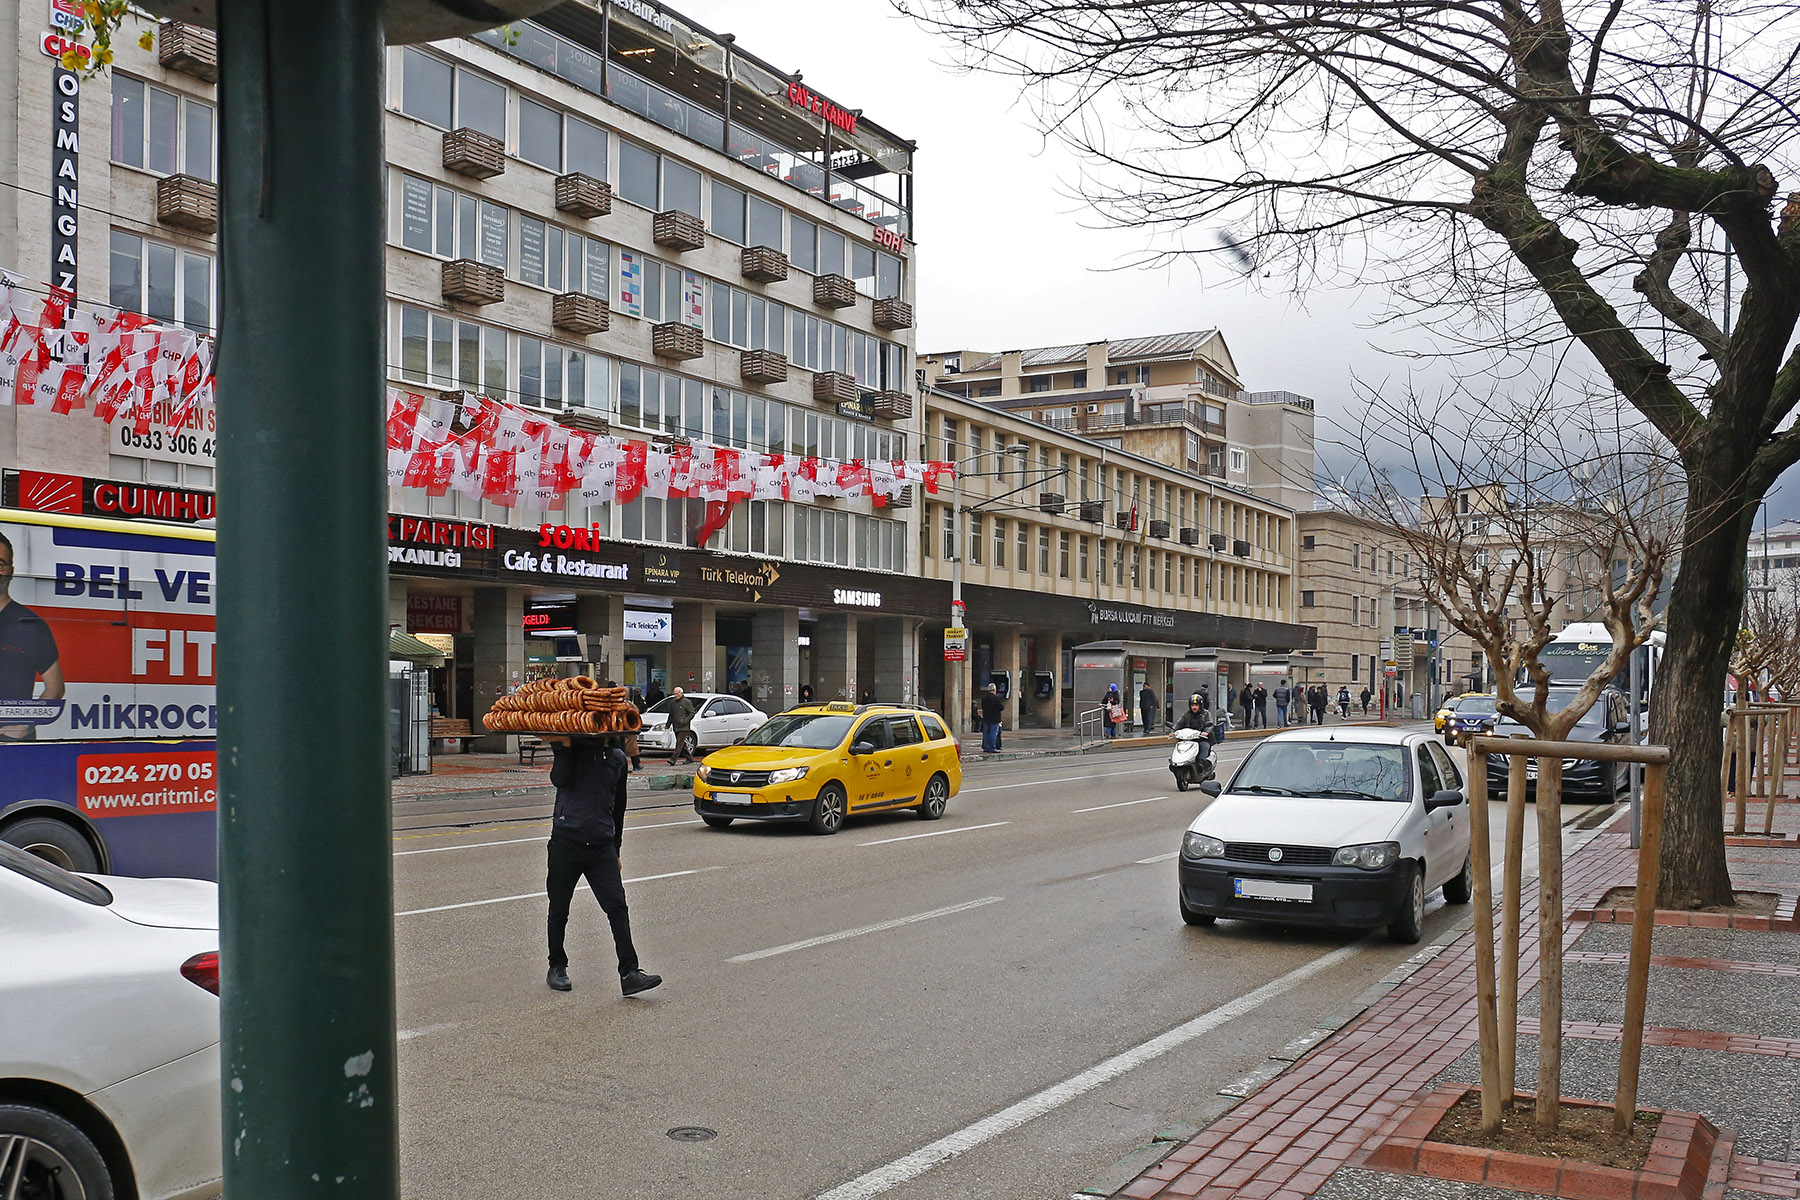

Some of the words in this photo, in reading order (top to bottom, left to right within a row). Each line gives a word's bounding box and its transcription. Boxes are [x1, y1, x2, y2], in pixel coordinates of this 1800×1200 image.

[811, 96, 820, 114] &
[822, 100, 858, 135] KAHVE
[162, 349, 182, 362] CHP
[41, 384, 57, 395] CHP
[400, 517, 494, 550] PARTİSİ
[538, 522, 600, 552] SORİ
[503, 549, 538, 573] Cafe
[540, 553, 553, 574] &
[556, 554, 629, 581] Restaurant
[701, 567, 722, 583] Türk
[725, 568, 764, 587] Telekom
[55, 562, 142, 600] BEL
[154, 568, 211, 605] VE
[833, 589, 881, 607] SAMSUNG
[625, 620, 637, 630] Türk
[638, 621, 659, 632] Telekom
[85, 765, 138, 785] 0224
[144, 763, 182, 783] 270
[187, 761, 212, 781] 05
